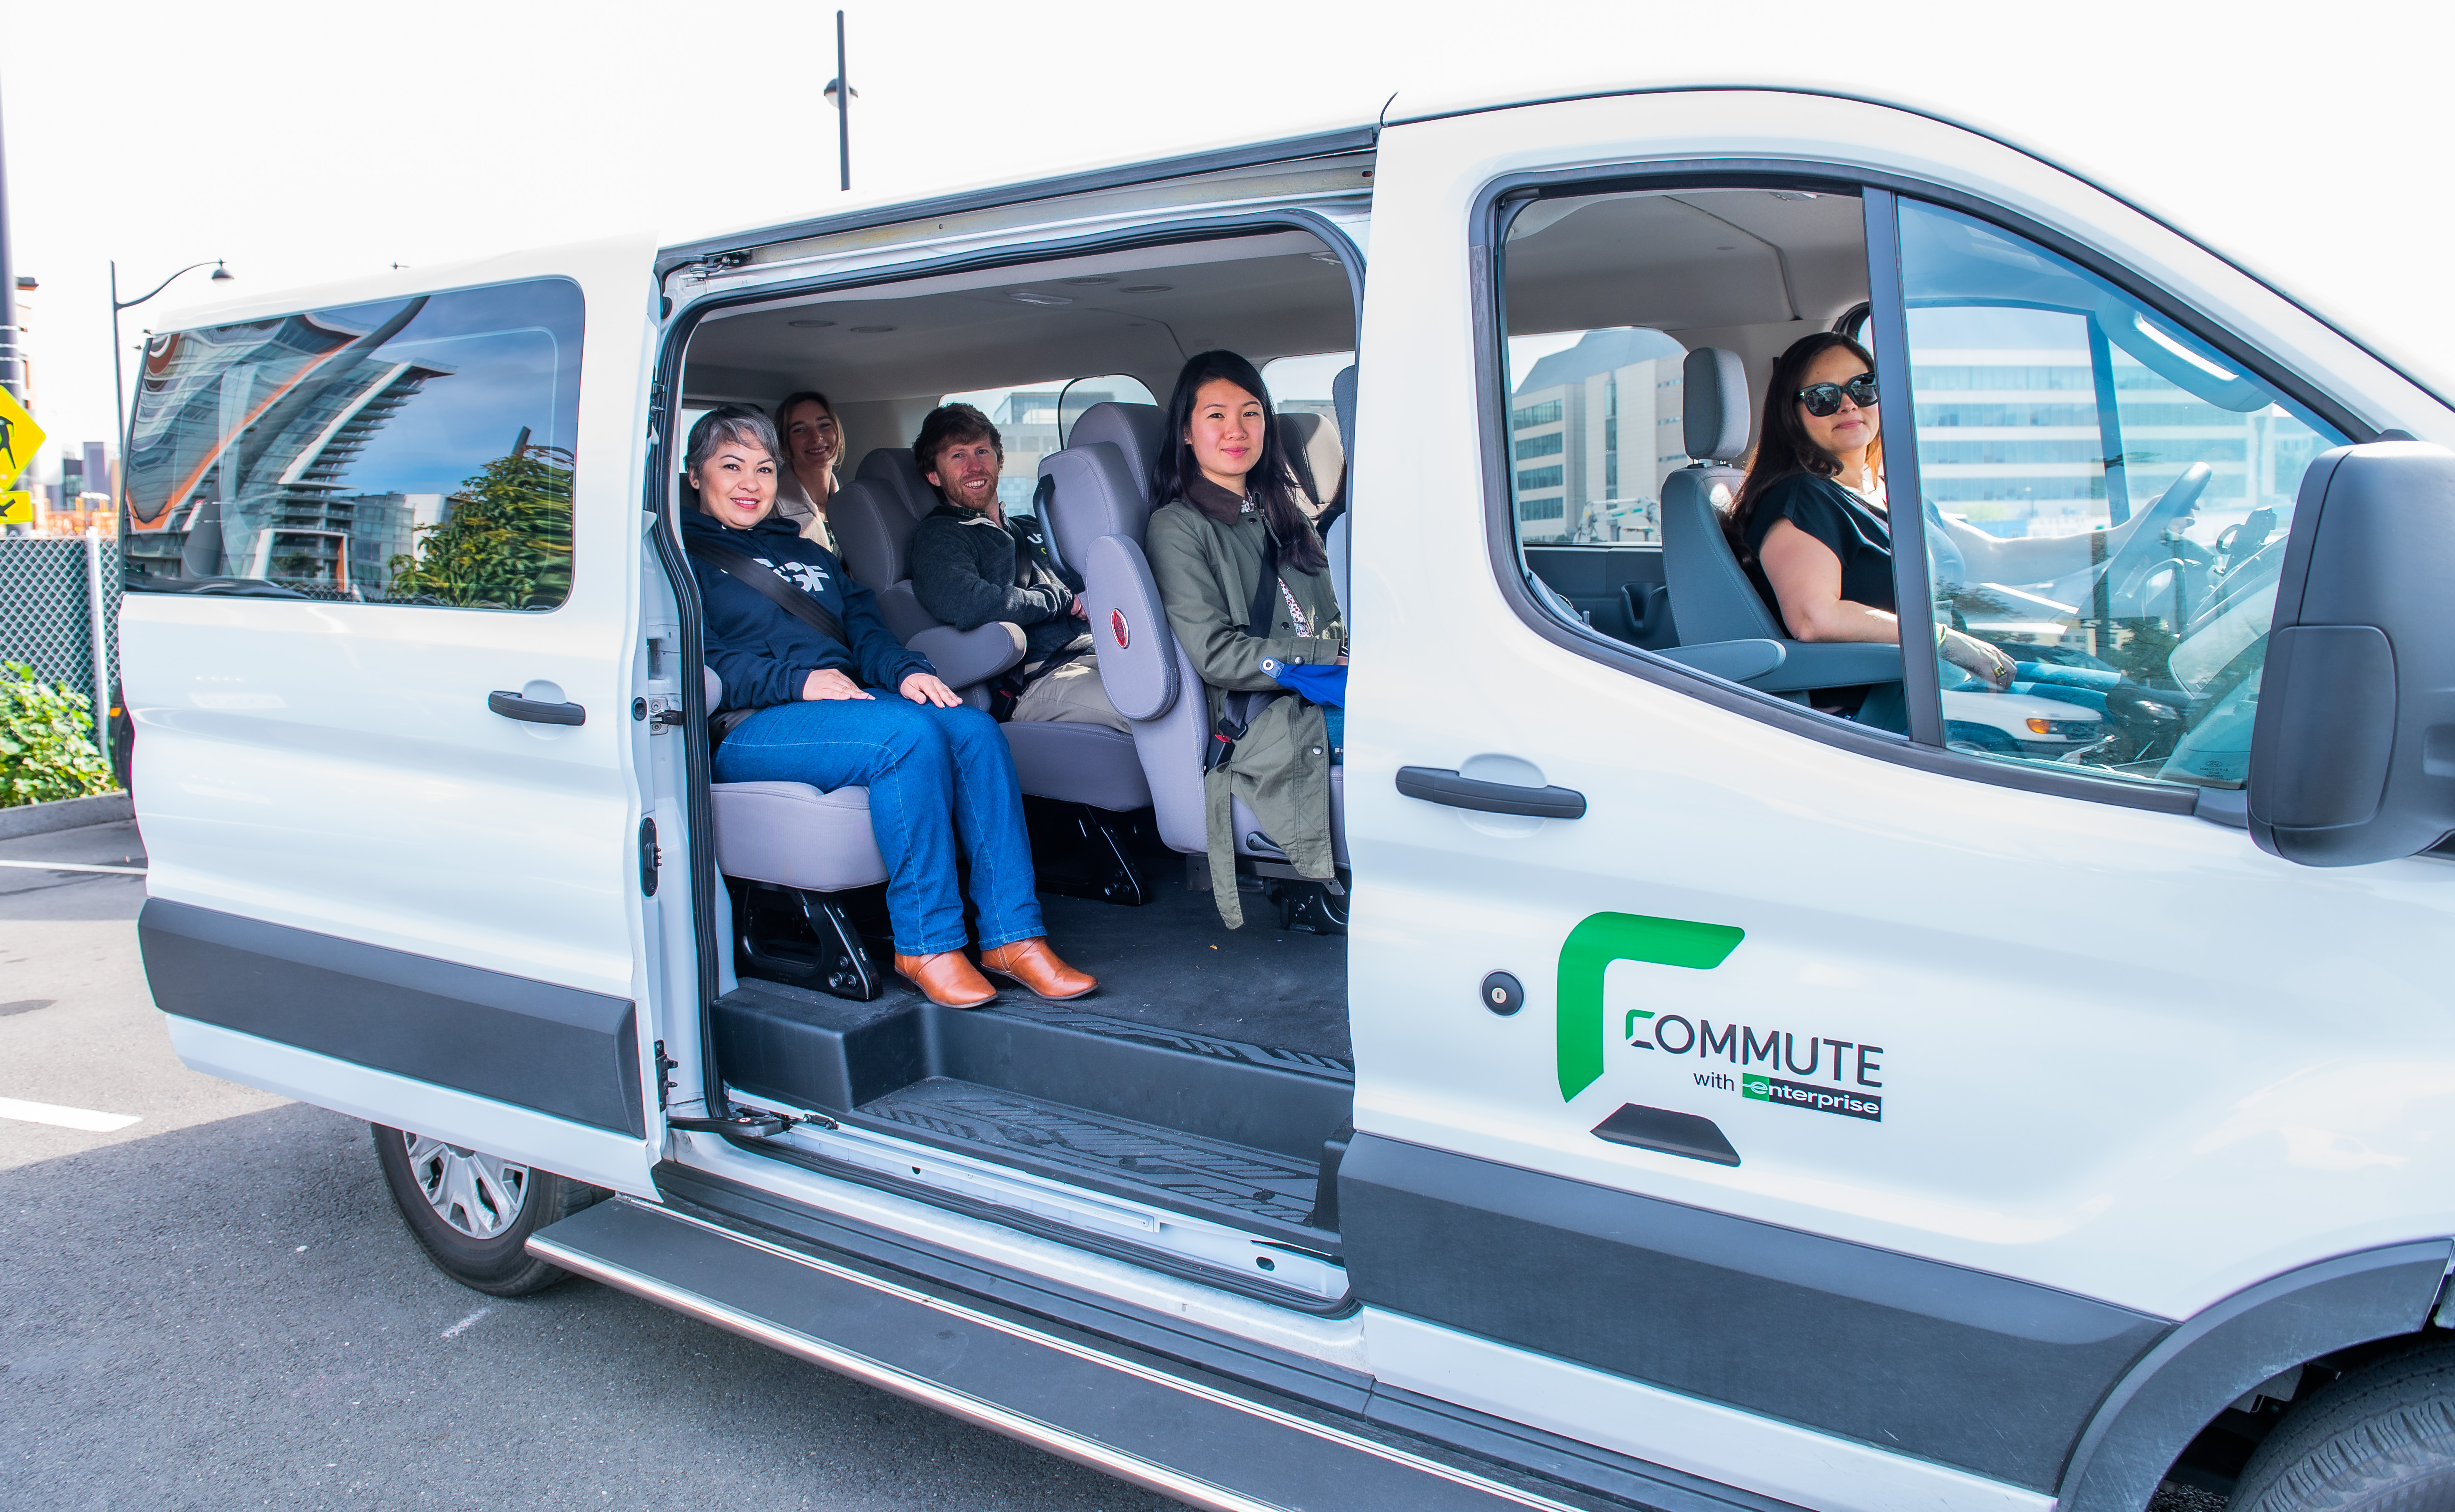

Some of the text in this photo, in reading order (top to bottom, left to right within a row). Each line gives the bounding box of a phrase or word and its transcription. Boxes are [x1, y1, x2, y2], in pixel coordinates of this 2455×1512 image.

[1626, 1009, 1884, 1088] COMMUTE
[1693, 1072, 1880, 1115] with enterprise
